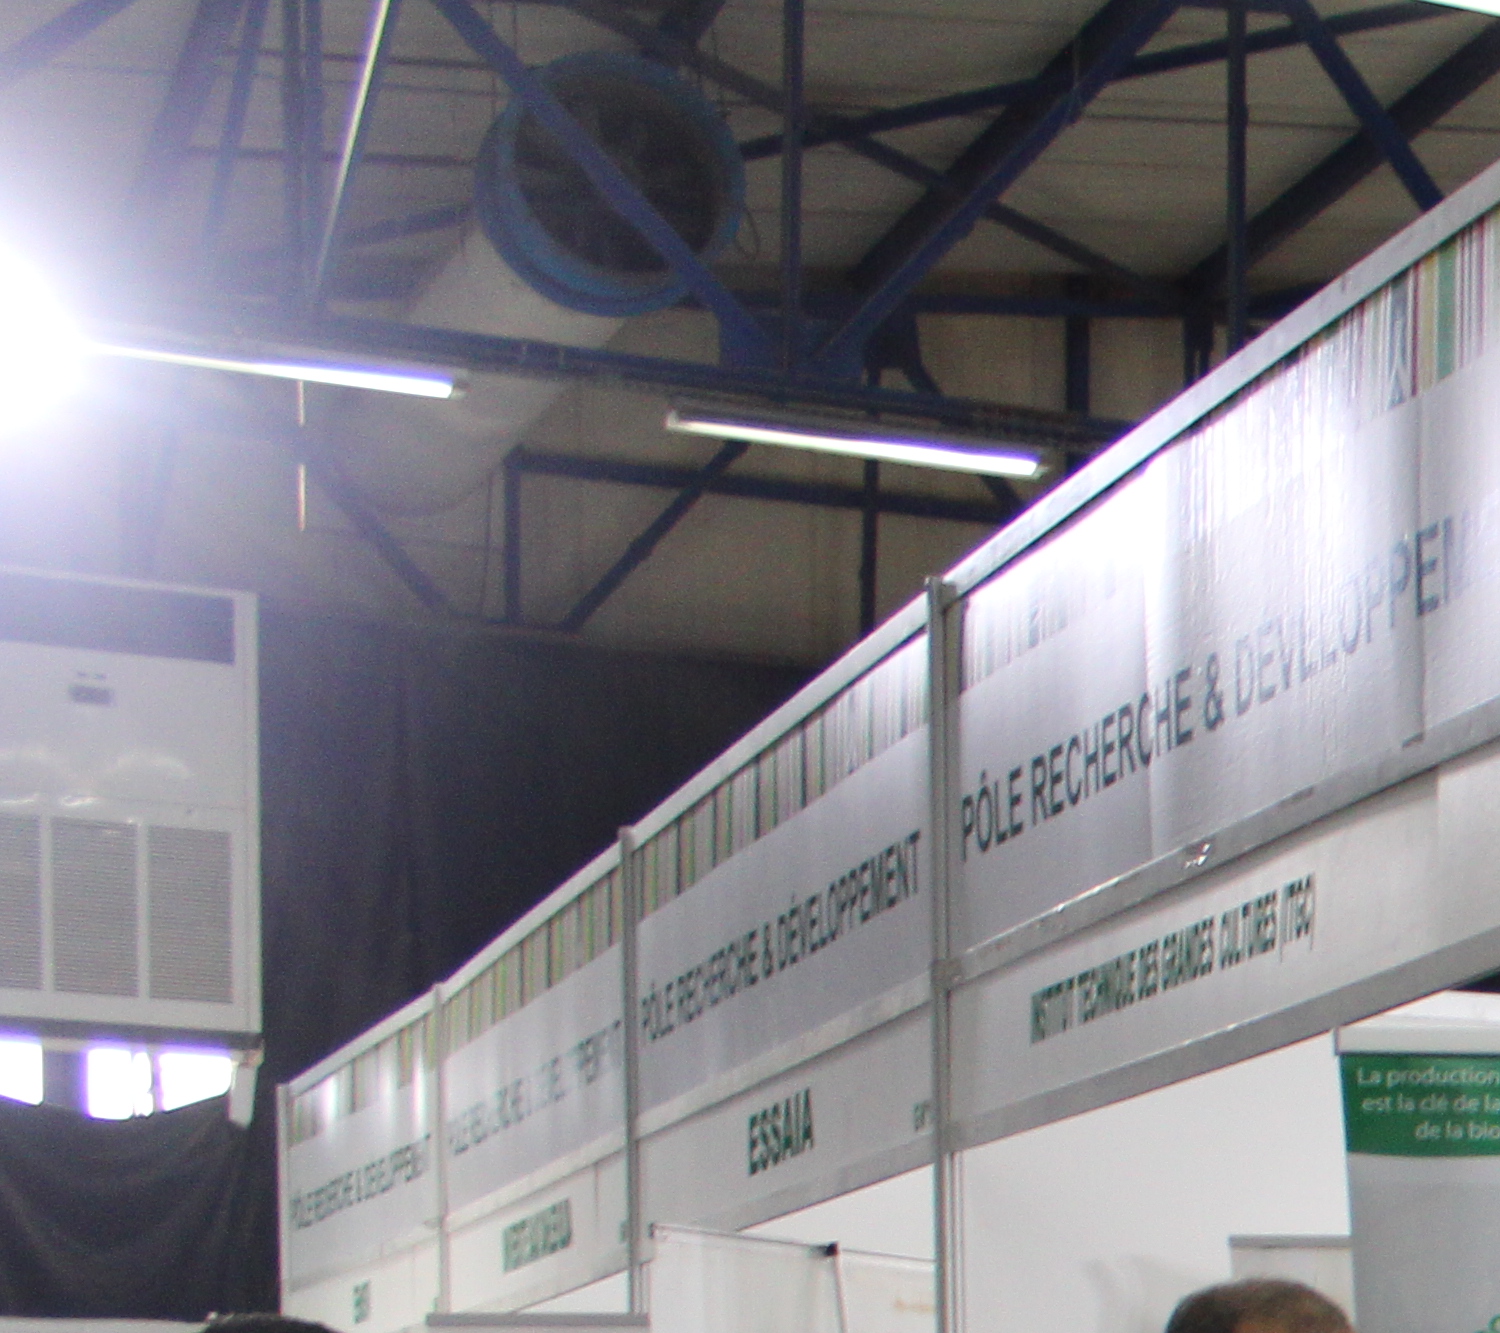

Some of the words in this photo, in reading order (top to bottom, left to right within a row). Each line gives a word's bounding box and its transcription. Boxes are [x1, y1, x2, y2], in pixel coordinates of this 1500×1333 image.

[961, 758, 1023, 863] PÔLE
[1032, 666, 1193, 826] RECHERCHE
[1203, 652, 1225, 732] &
[1357, 1067, 1381, 1084] La
[1386, 1066, 1500, 1089] production
[1362, 1095, 1390, 1114] est
[1397, 1093, 1414, 1112] la
[1419, 1093, 1446, 1113] clé
[1452, 1094, 1480, 1113] de
[1415, 1121, 1440, 1140] de
[1445, 1121, 1464, 1140] la
